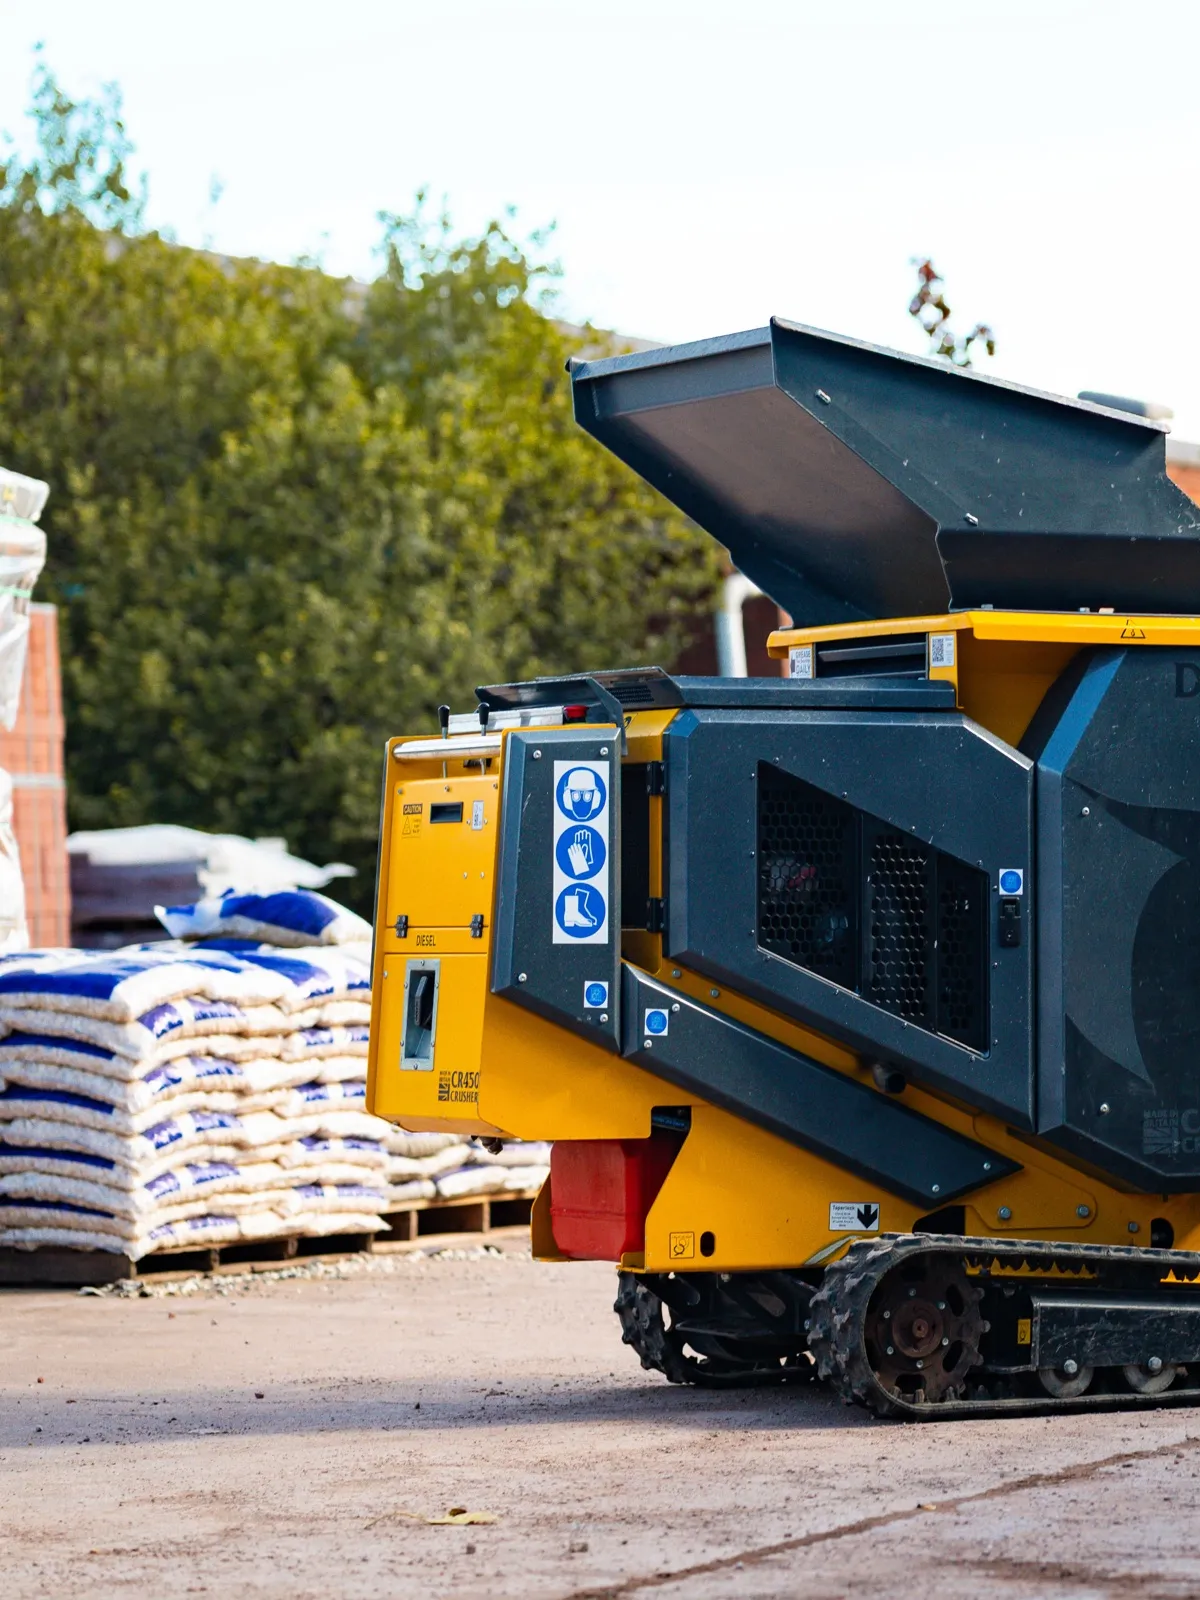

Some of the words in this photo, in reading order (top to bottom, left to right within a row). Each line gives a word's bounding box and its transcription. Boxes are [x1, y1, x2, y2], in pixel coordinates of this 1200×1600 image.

[416, 934, 436, 946] DIESEL
[451, 1070, 480, 1089] CR450
[450, 1090, 479, 1102] CRUSHER
